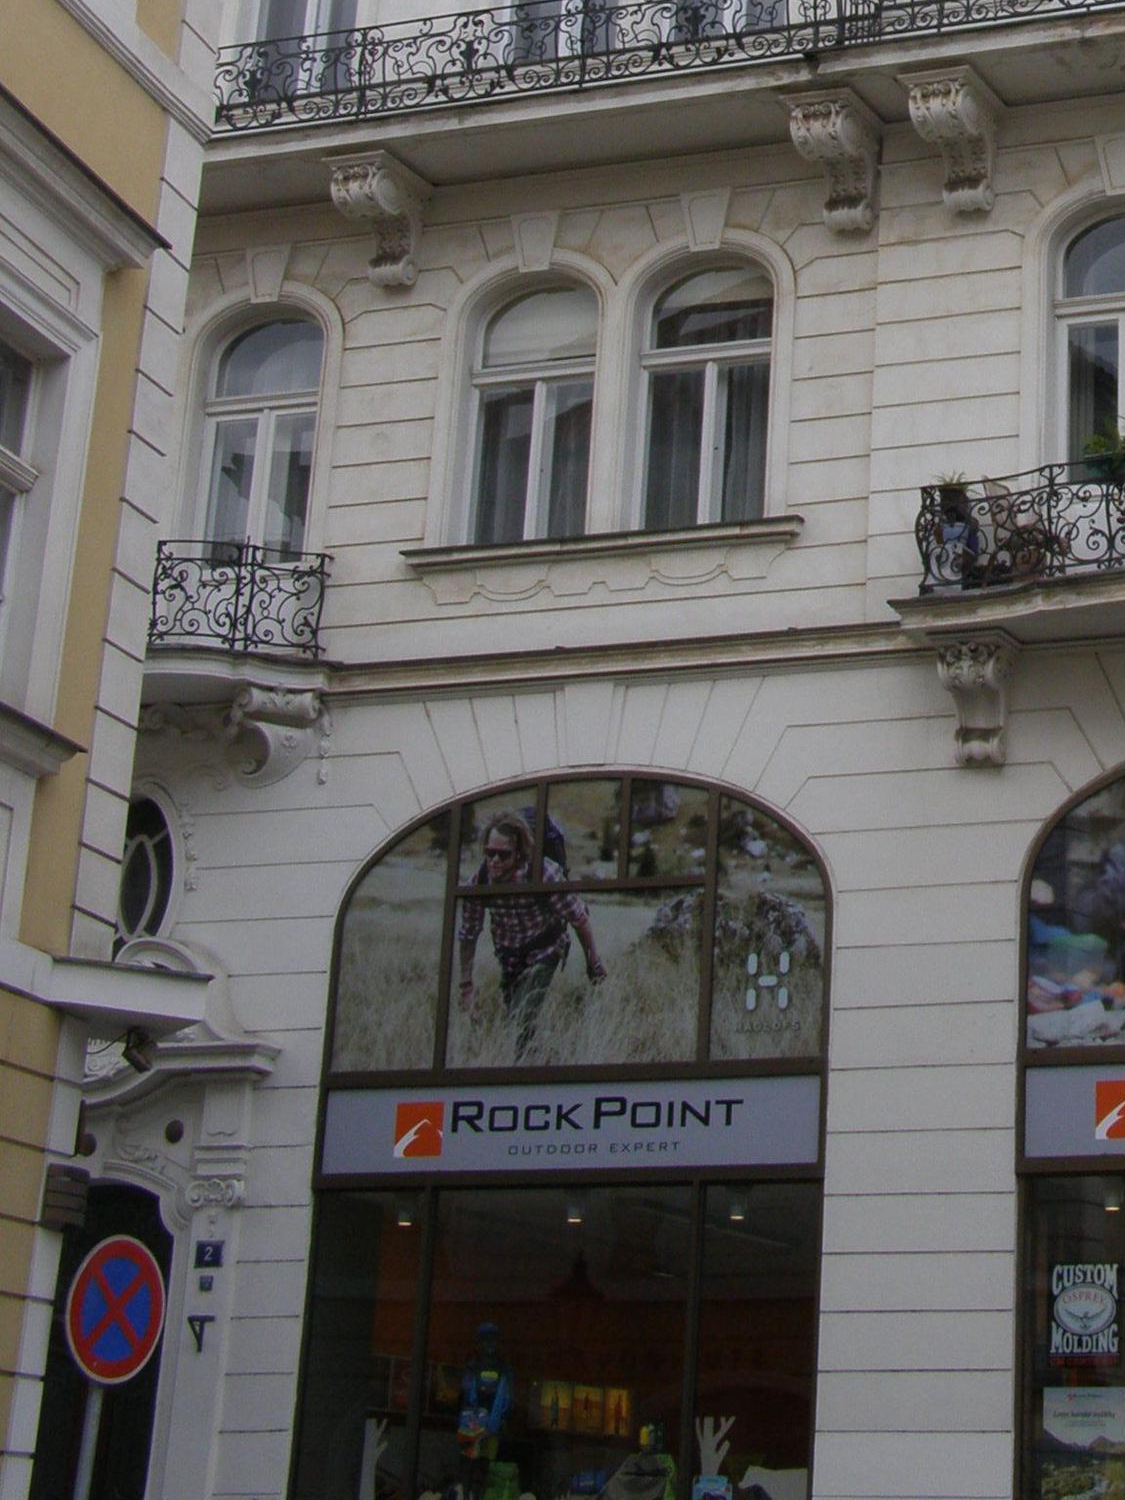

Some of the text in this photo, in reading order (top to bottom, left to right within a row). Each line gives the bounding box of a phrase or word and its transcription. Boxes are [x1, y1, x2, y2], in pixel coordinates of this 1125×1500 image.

[507, 1140, 681, 1156] OUTDOOR EXPERT
[204, 1246, 213, 1260] 2
[1051, 1263, 1119, 1300] CUSTOM
[1049, 1320, 1120, 1354] MOLDING
